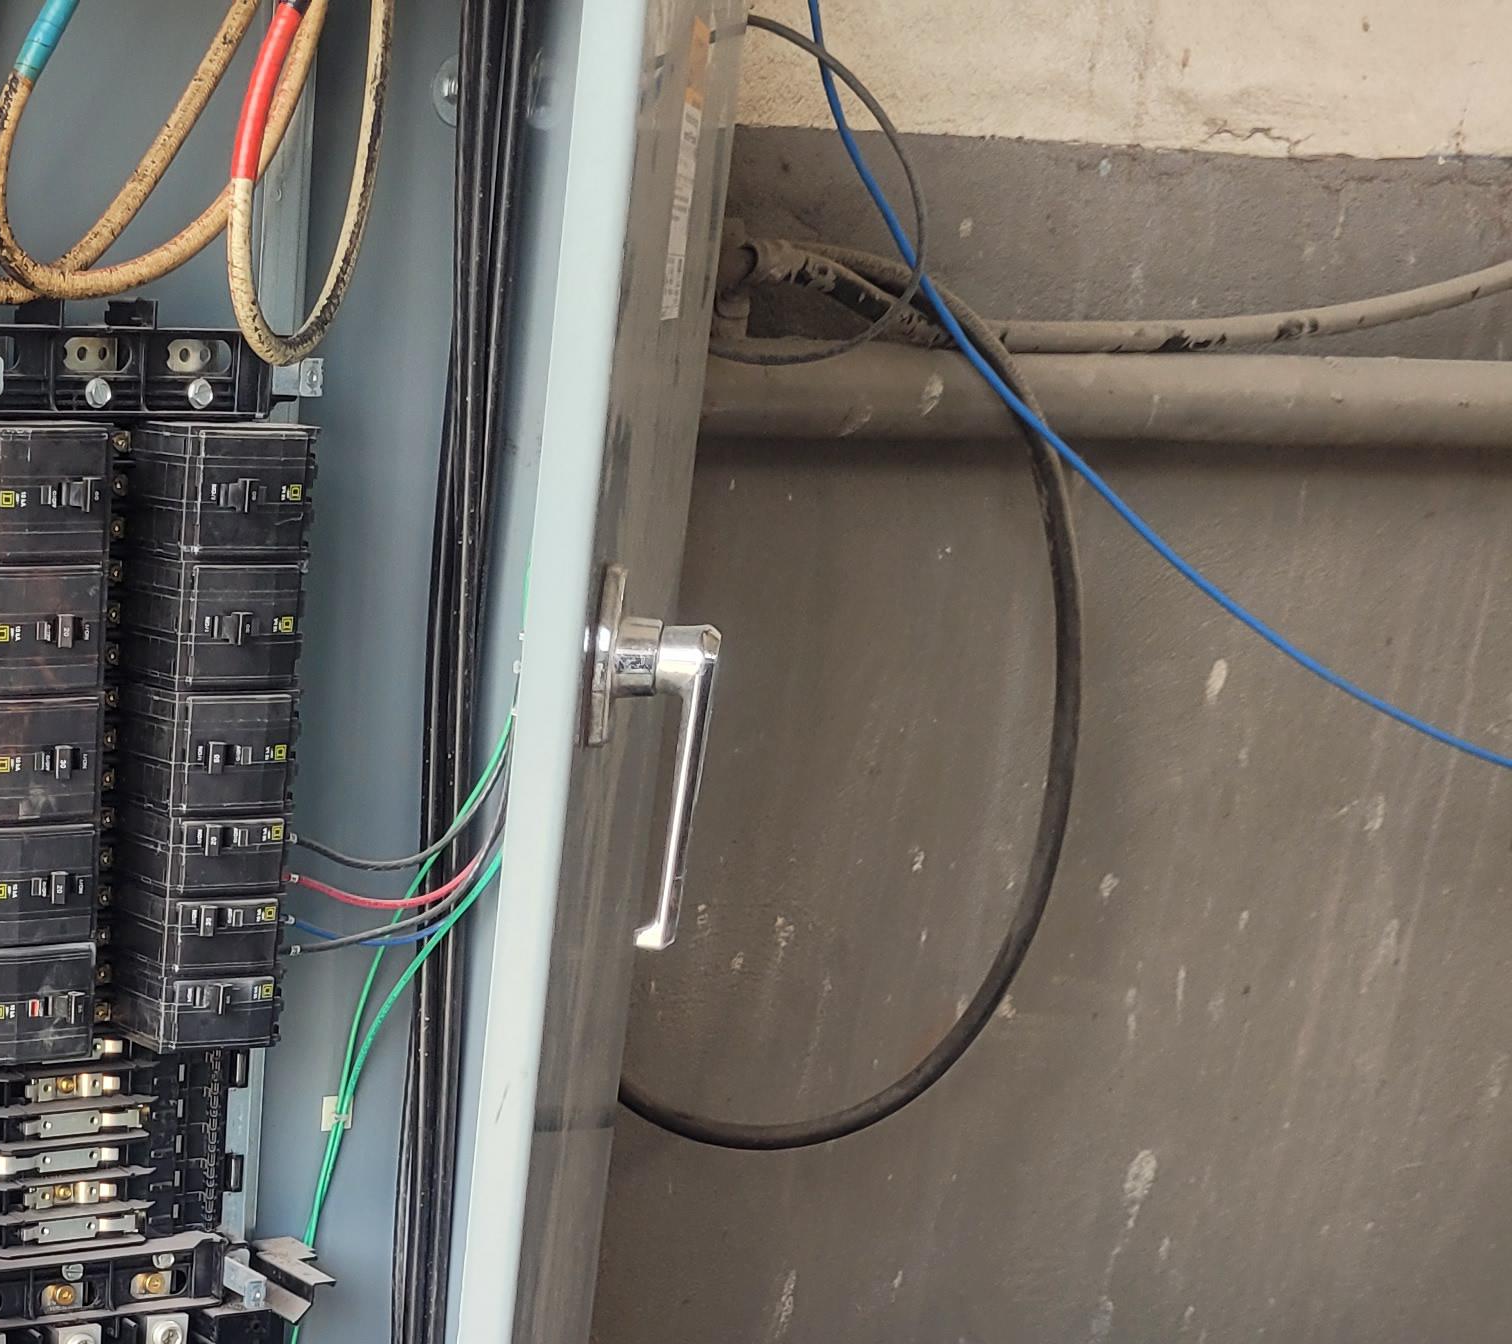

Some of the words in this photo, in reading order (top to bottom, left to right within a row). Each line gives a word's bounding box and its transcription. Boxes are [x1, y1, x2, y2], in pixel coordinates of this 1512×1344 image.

[63, 627, 70, 637] 20
[59, 759, 67, 769] 30
[56, 884, 63, 894] 20
